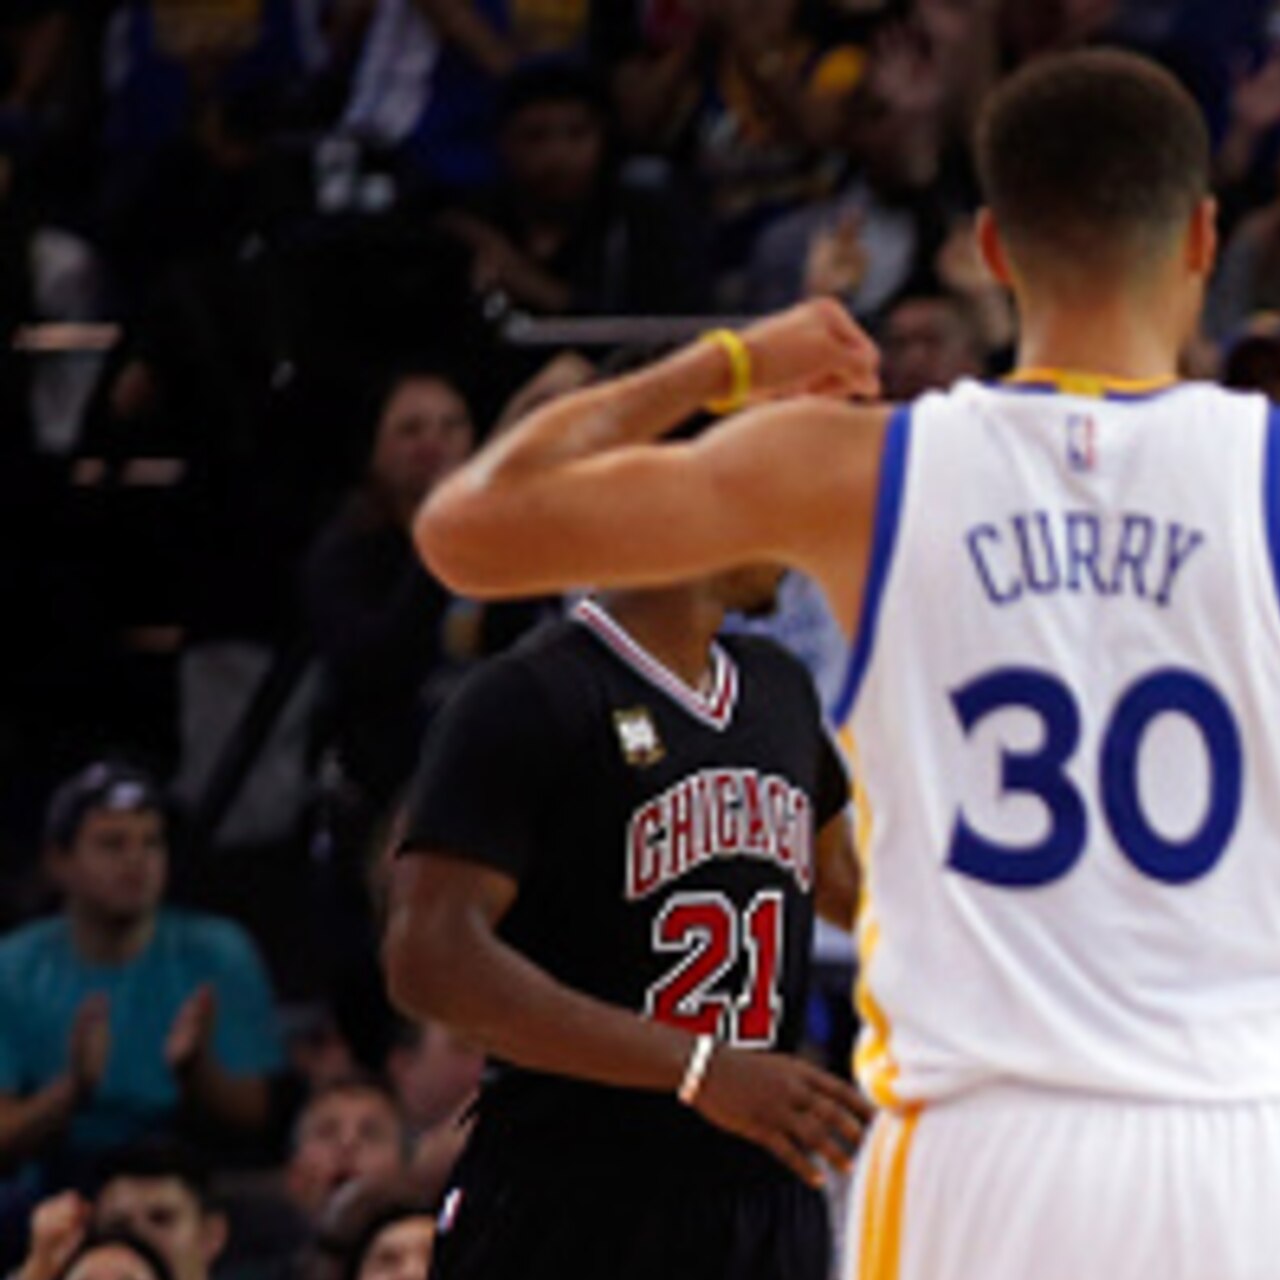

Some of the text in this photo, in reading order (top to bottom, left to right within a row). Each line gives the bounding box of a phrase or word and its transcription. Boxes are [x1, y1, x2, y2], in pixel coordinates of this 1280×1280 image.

[965, 508, 1205, 609] CURRY
[944, 663, 1244, 891] 30
[644, 890, 783, 1048] 21
